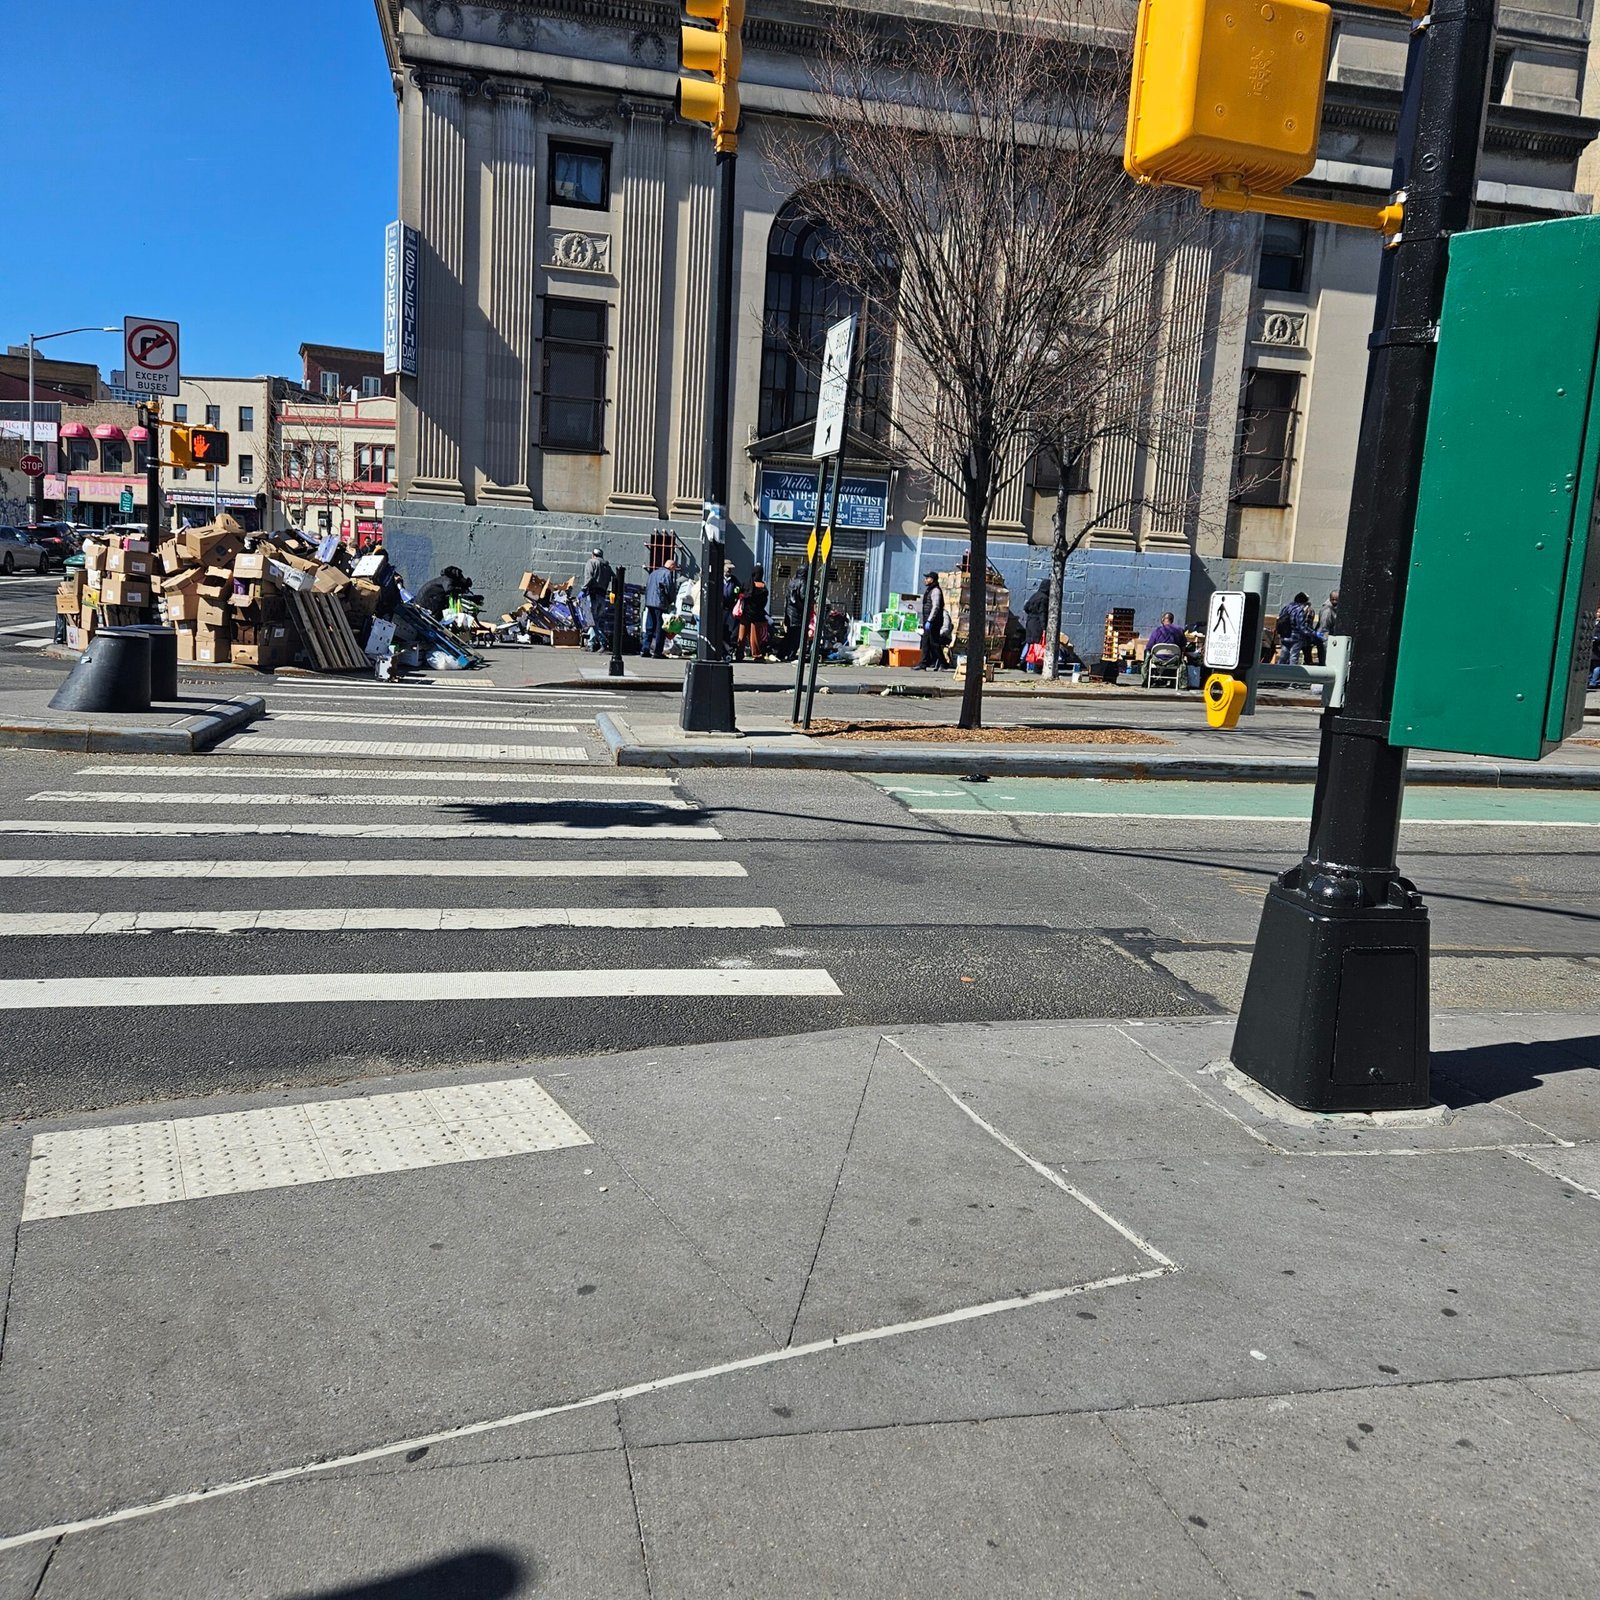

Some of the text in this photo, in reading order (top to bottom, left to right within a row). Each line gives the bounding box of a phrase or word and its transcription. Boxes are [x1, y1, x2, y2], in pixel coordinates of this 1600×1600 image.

[387, 247, 396, 344] SEVENTH
[404, 249, 416, 347] SEVENTH
[402, 344, 416, 360] DAY
[135, 371, 169, 382] EXCEPT
[137, 381, 168, 391] BUSES
[4, 421, 55, 431] BIG HART
[21, 461, 43, 471] STOP
[780, 475, 813, 490] Willis
[765, 488, 882, 507] SEVENTH-DY DVENTIST
